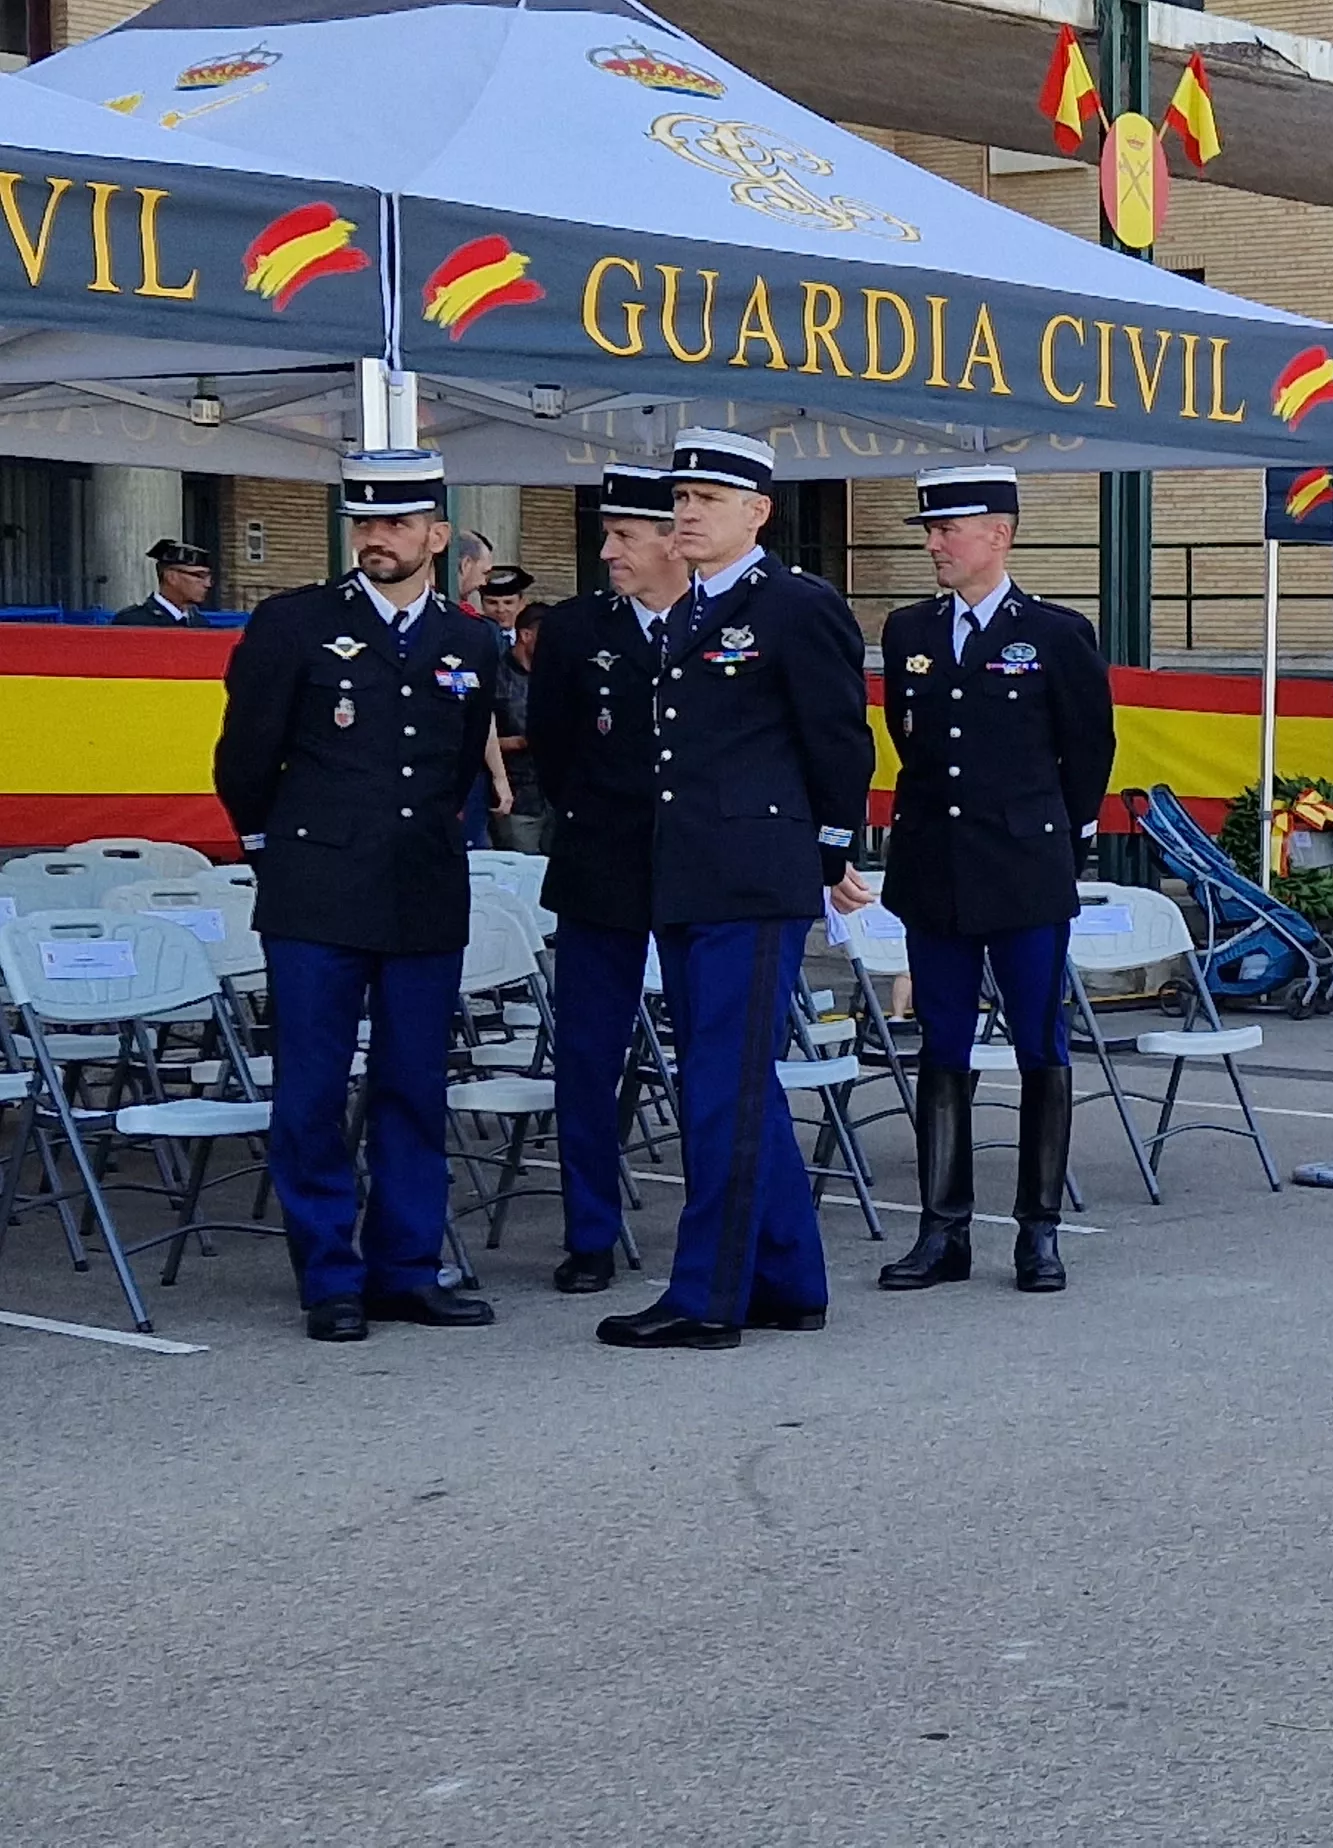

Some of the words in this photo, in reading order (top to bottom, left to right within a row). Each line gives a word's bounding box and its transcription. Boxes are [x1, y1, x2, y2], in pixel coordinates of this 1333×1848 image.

[0, 171, 198, 300] VIL
[581, 256, 1012, 395] GUARDIA
[1040, 314, 1247, 424] CIVIL
